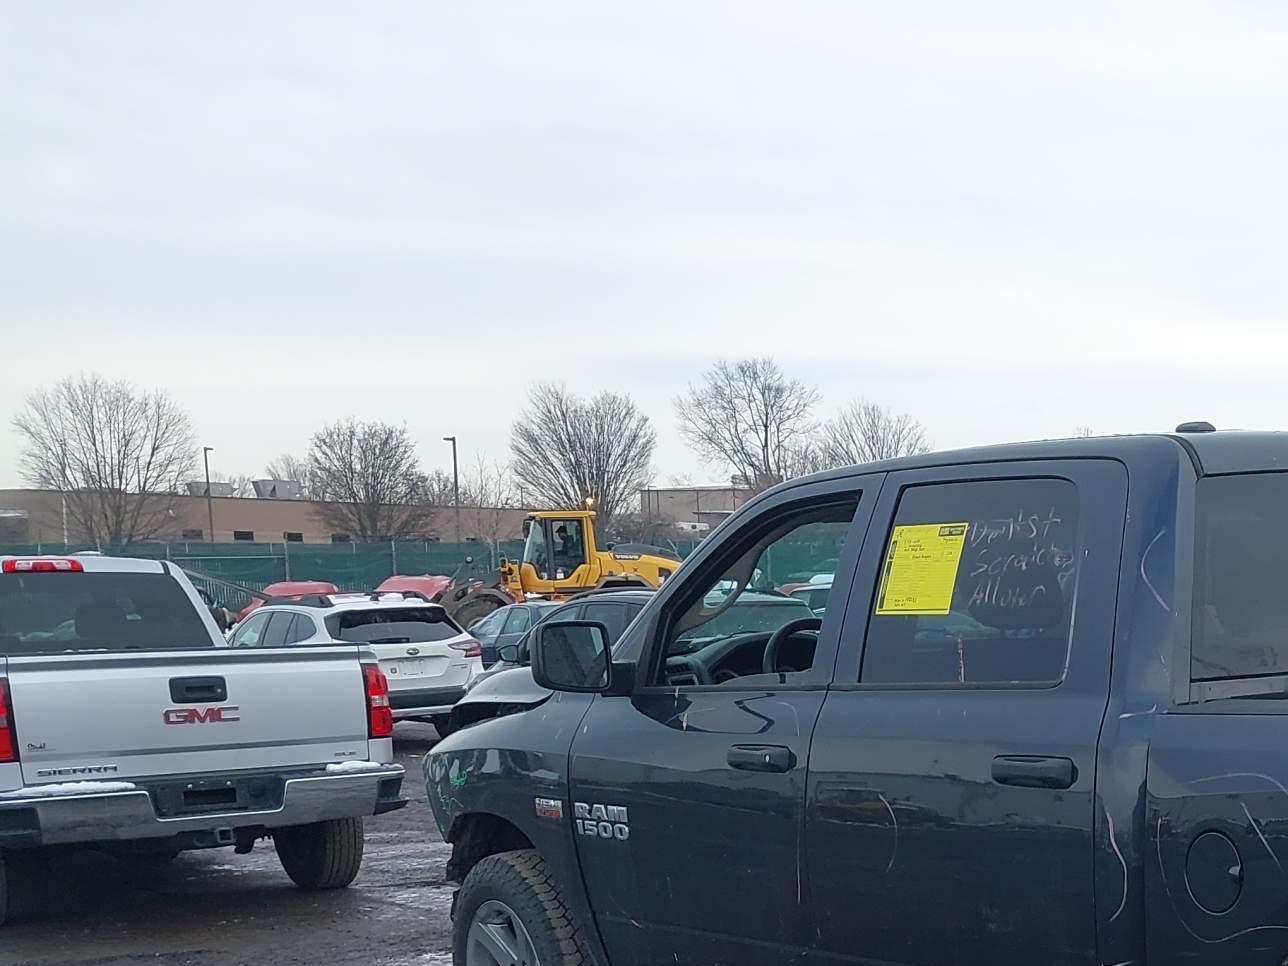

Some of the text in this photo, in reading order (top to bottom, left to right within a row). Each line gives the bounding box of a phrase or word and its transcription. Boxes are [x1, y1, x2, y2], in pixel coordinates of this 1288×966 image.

[163, 705, 241, 725] GMC
[37, 764, 118, 777] SIERRA
[574, 802, 628, 823] RAM
[575, 819, 630, 841] 1500
